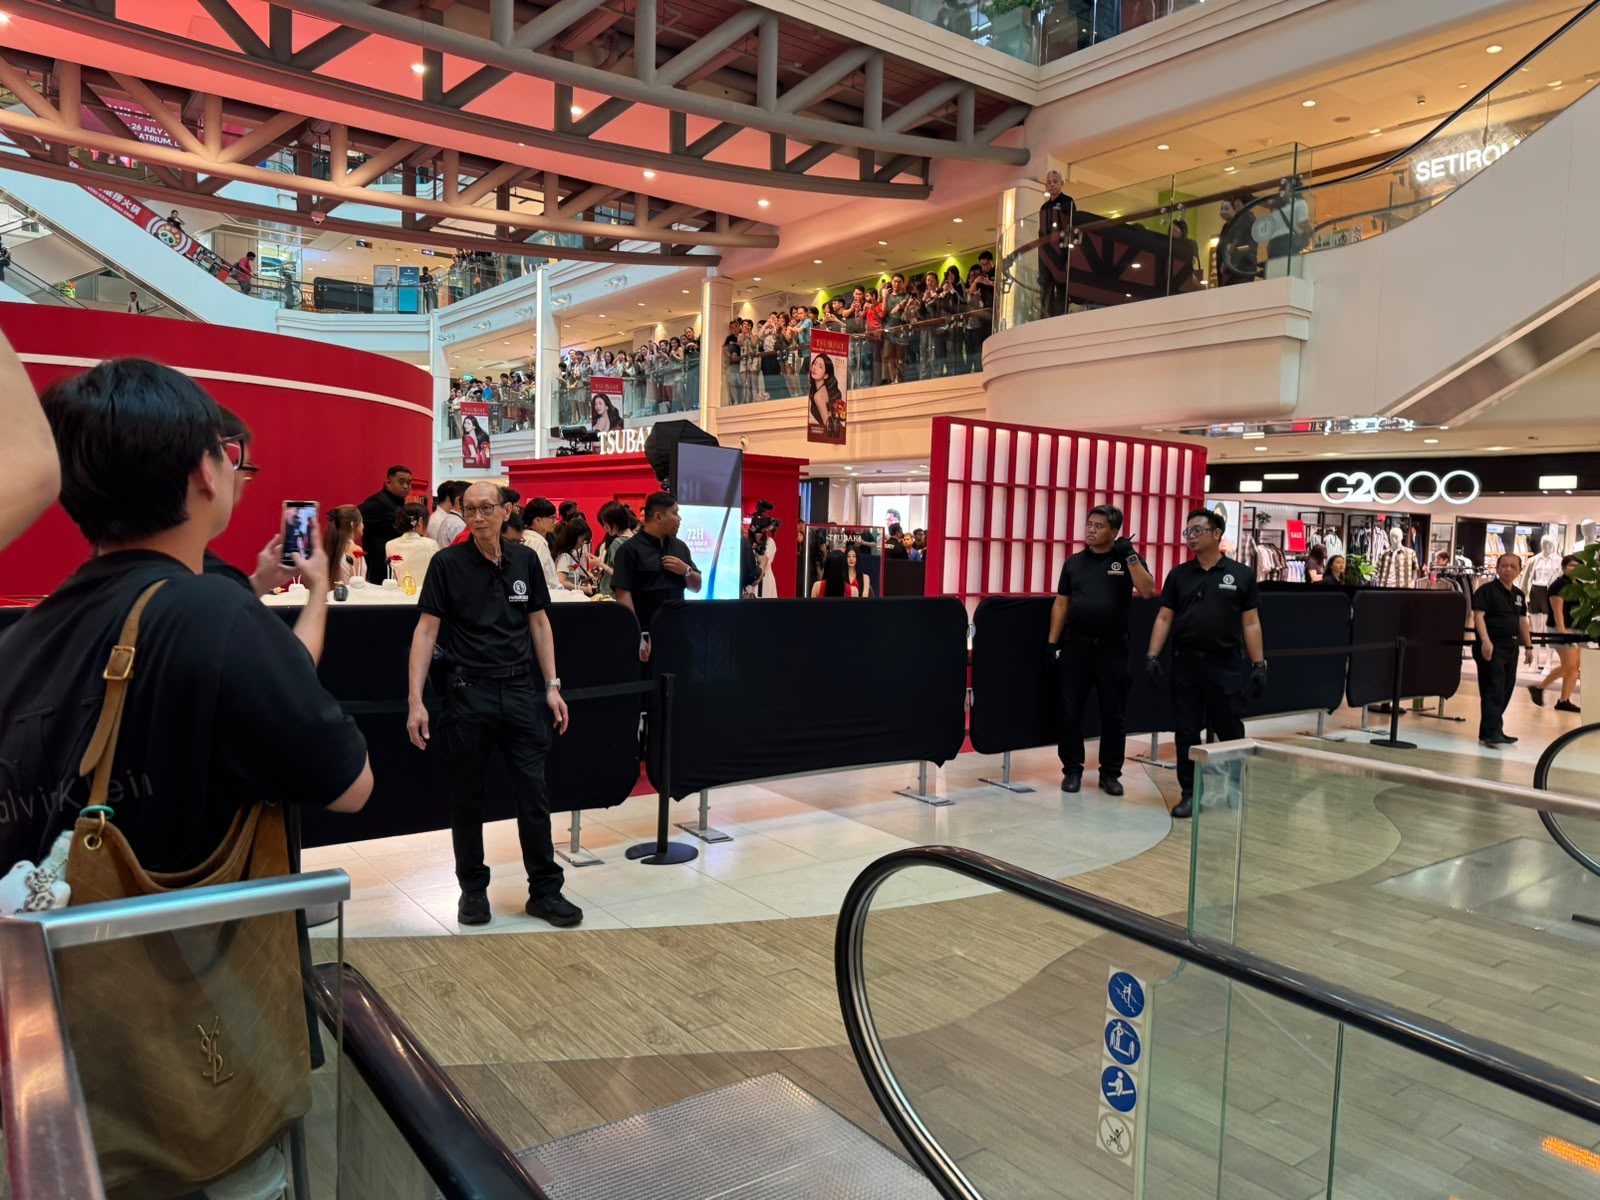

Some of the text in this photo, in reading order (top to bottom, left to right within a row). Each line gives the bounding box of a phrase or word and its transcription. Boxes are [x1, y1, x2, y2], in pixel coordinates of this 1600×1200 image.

[131, 122, 142, 131] 26
[143, 125, 163, 135] JULY
[1320, 470, 1480, 504] G2000
[1290, 531, 1303, 539] SALE
